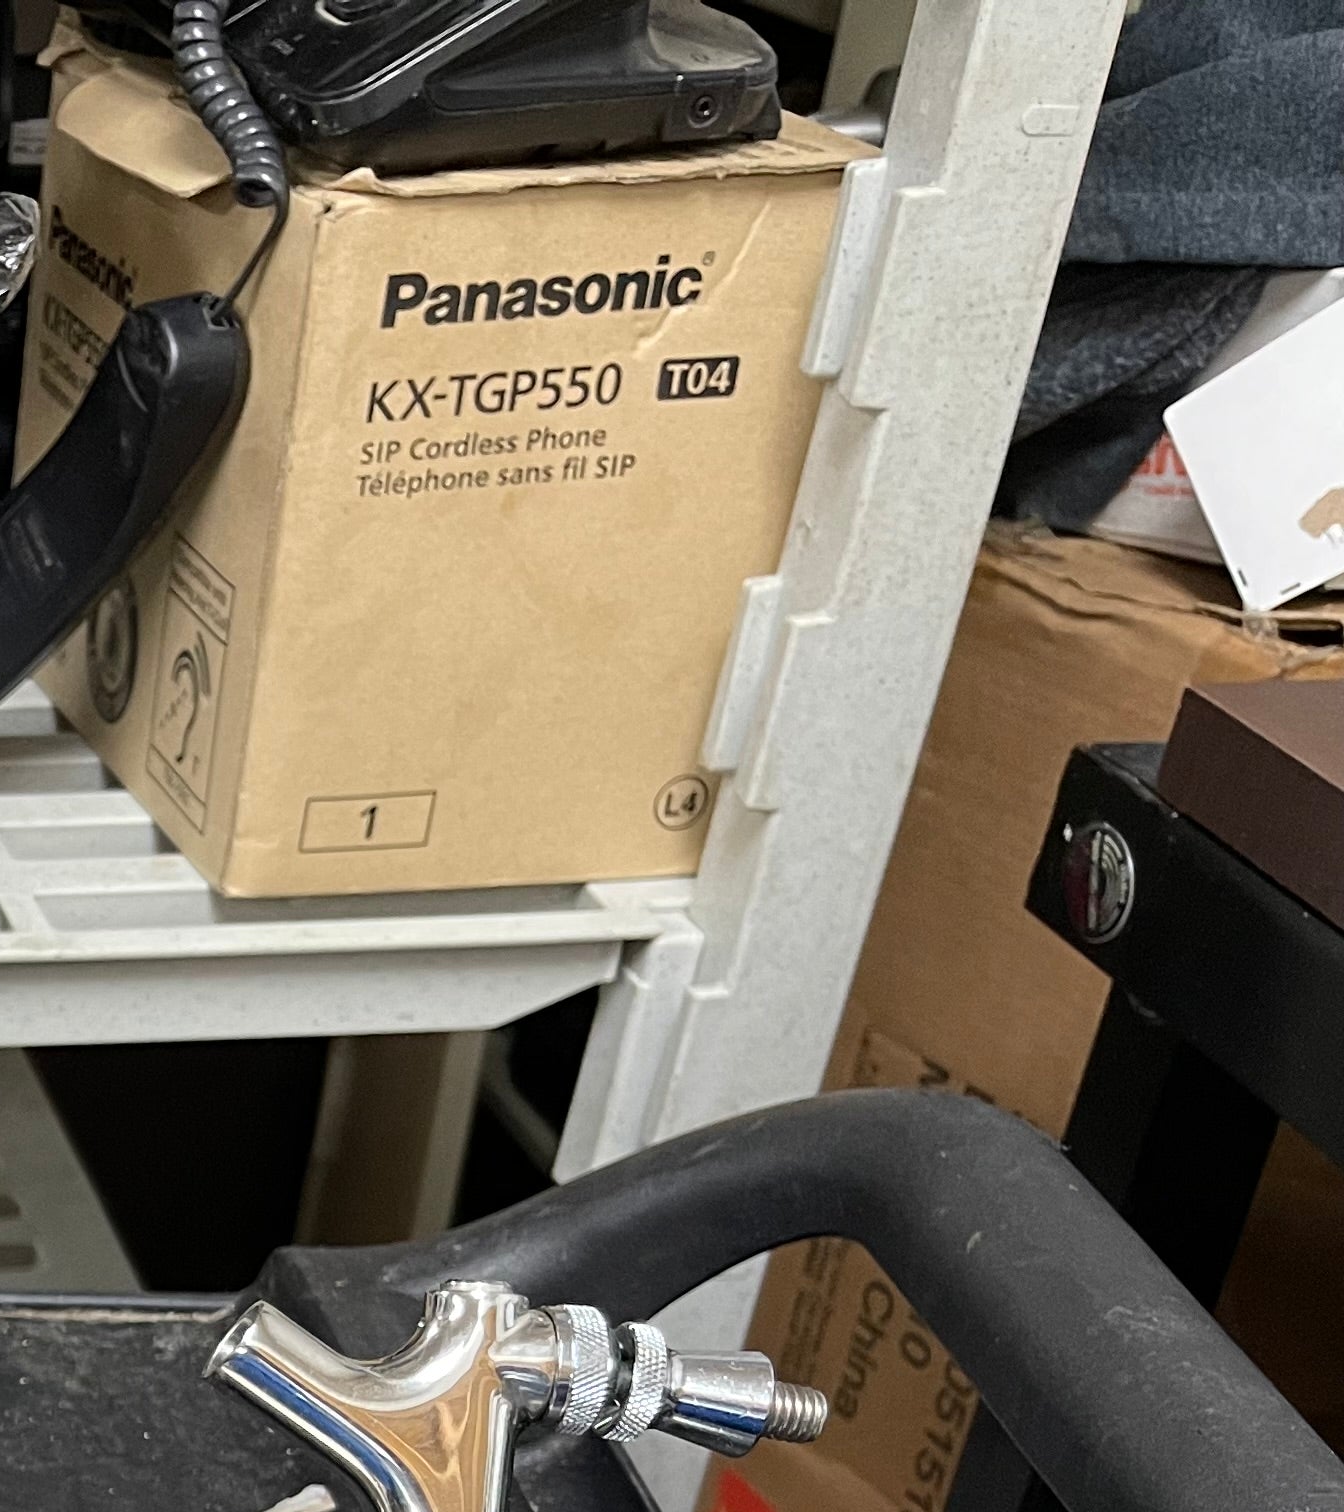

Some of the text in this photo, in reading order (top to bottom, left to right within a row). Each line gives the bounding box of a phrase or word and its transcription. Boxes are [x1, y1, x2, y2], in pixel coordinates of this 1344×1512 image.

[366, 361, 732, 423] KX-TGP550 T04
[360, 425, 607, 466] SIP Cordless Phone
[357, 453, 637, 499] Téléphone sans fil SIP
[359, 804, 378, 840] 1
[665, 790, 698, 818] L4
[833, 1280, 895, 1419] China
